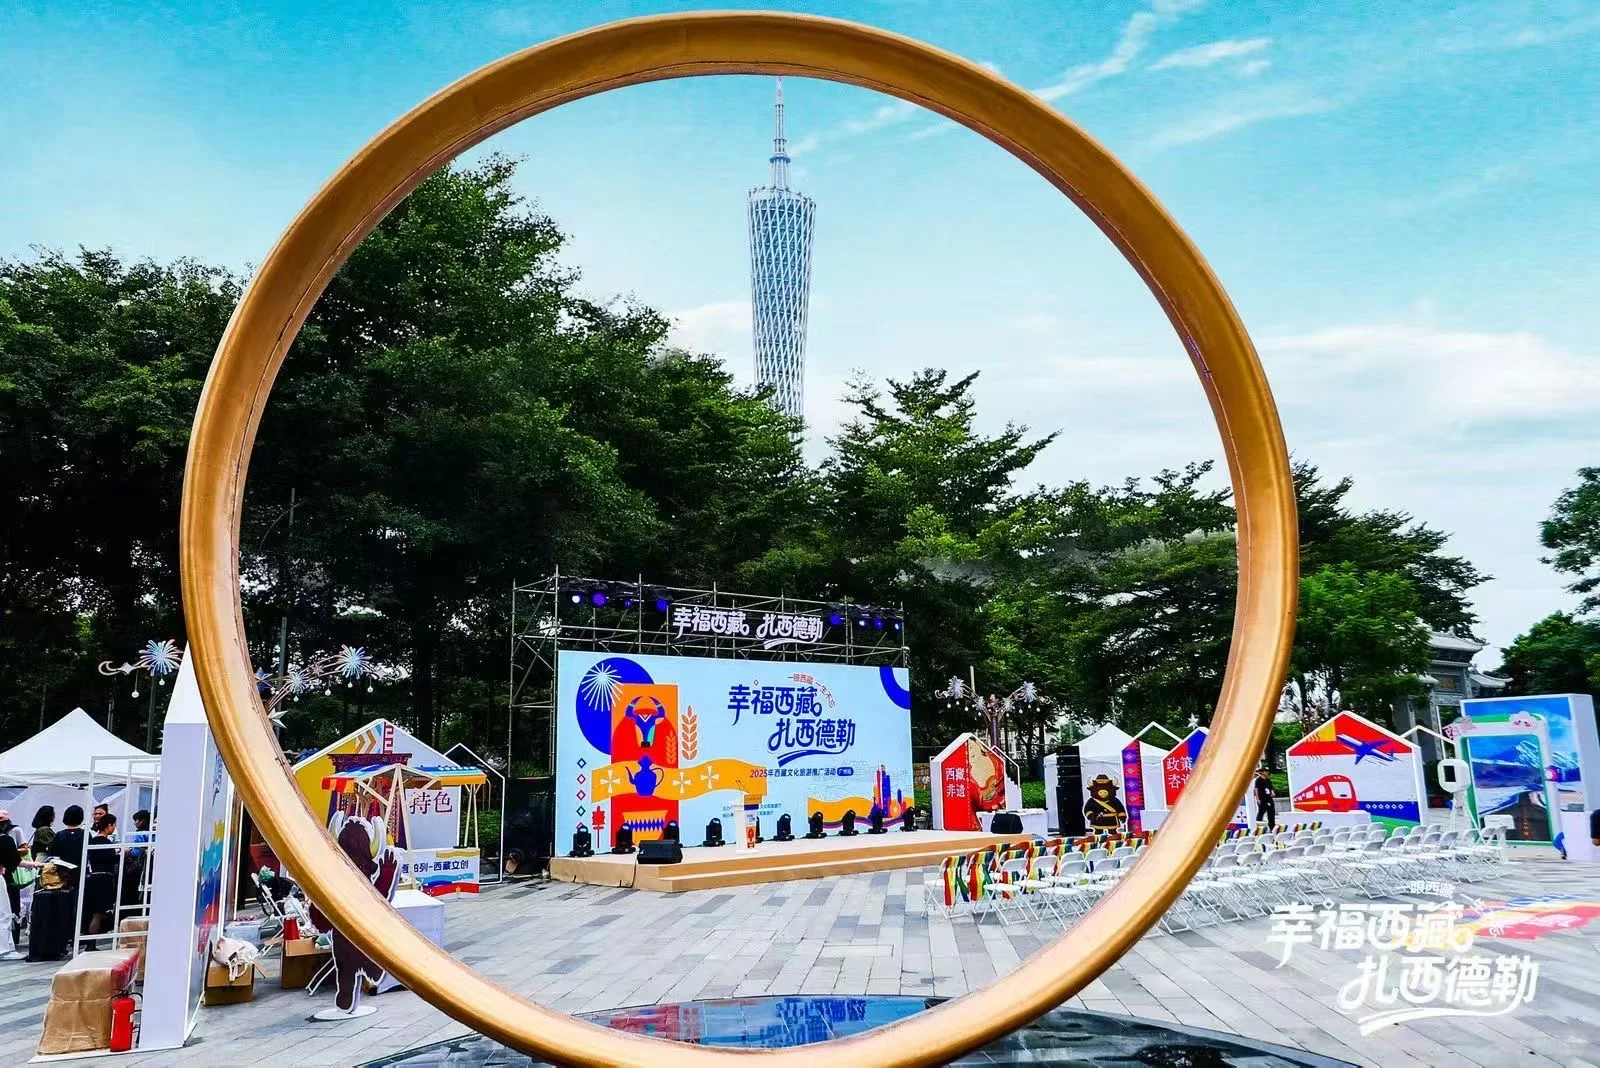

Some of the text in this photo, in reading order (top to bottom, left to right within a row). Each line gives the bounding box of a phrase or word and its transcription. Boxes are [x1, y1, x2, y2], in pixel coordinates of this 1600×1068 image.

[673, 607, 823, 650] 幸福西藏 扎西德勒
[728, 684, 822, 726] 幸福西藏
[768, 718, 855, 767] 扎西德勒
[1166, 756, 1193, 771] 政策
[945, 767, 965, 781] 西藏
